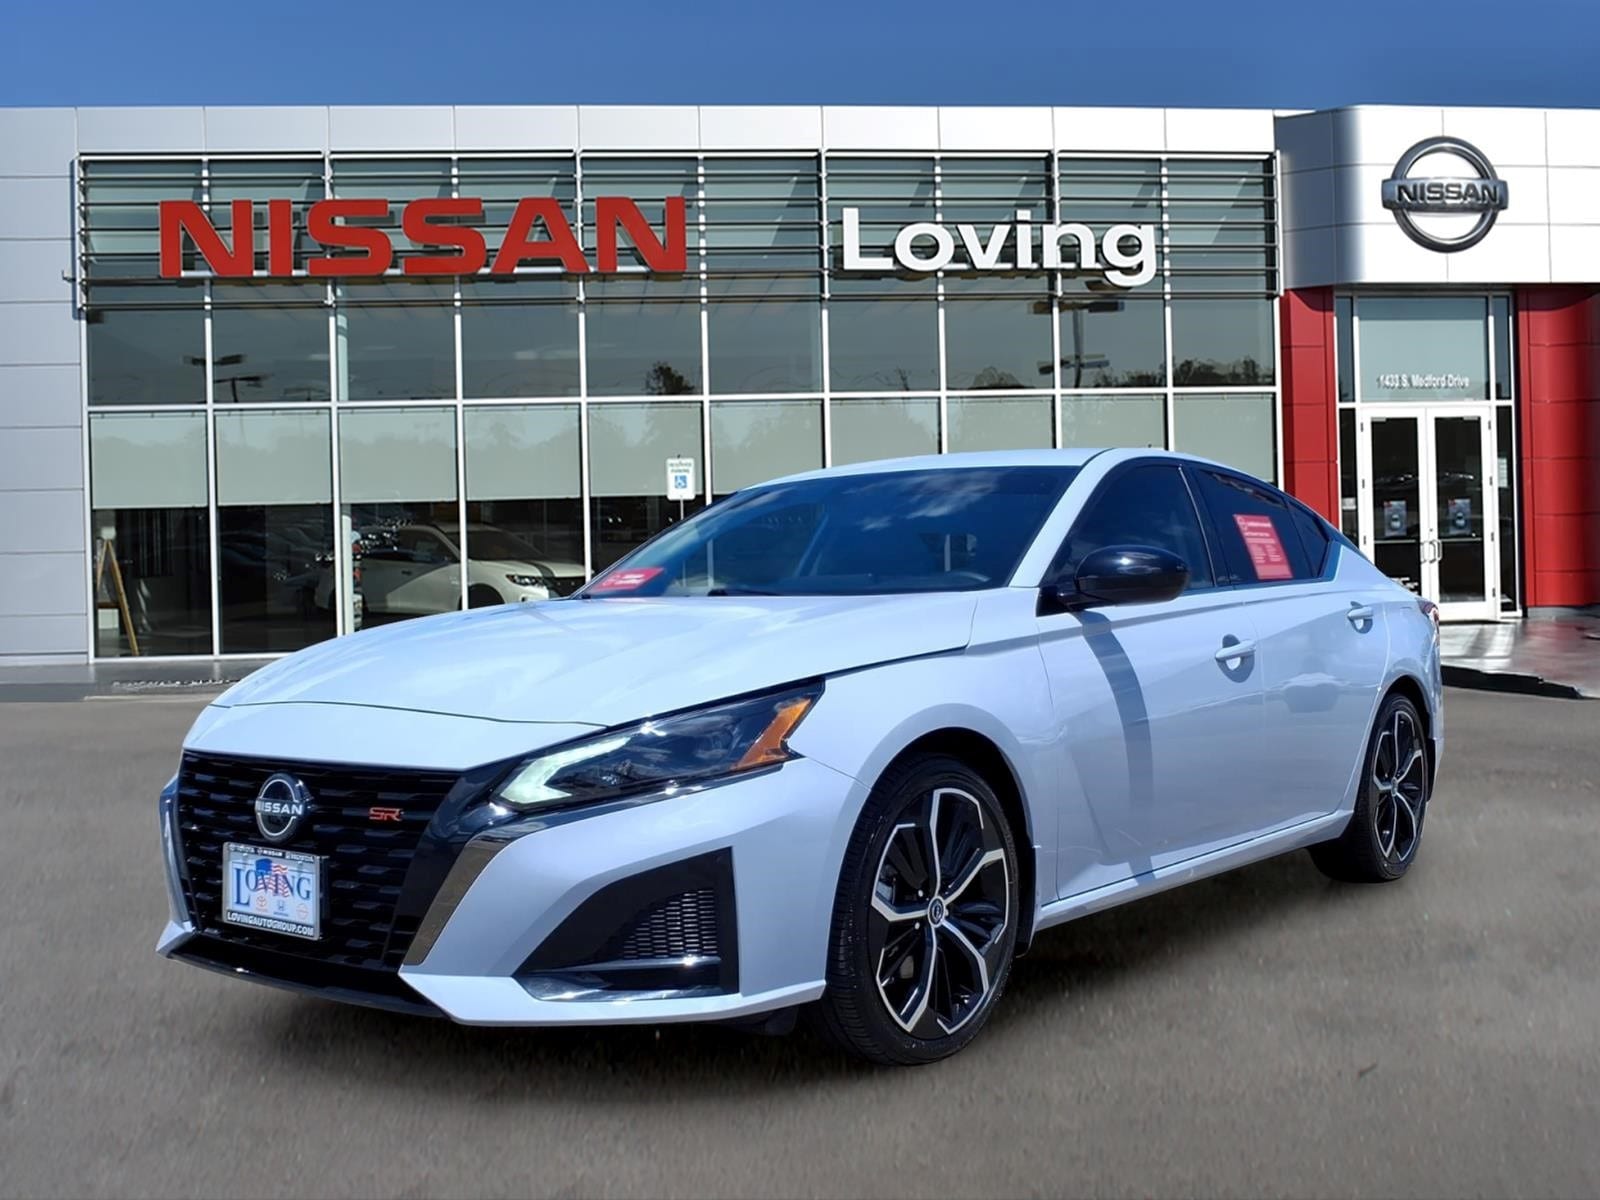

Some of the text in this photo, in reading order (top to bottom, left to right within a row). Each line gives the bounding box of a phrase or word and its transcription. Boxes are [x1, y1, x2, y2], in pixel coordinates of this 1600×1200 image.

[1397, 183, 1498, 203] NISSAN
[158, 196, 687, 277] NISSAN
[842, 207, 1157, 287] Loving
[1447, 373, 1470, 388] Drive
[369, 807, 404, 821] SR
[233, 867, 312, 907] LOVING
[227, 911, 314, 936] LOVINGAUTOGROUP.COM
